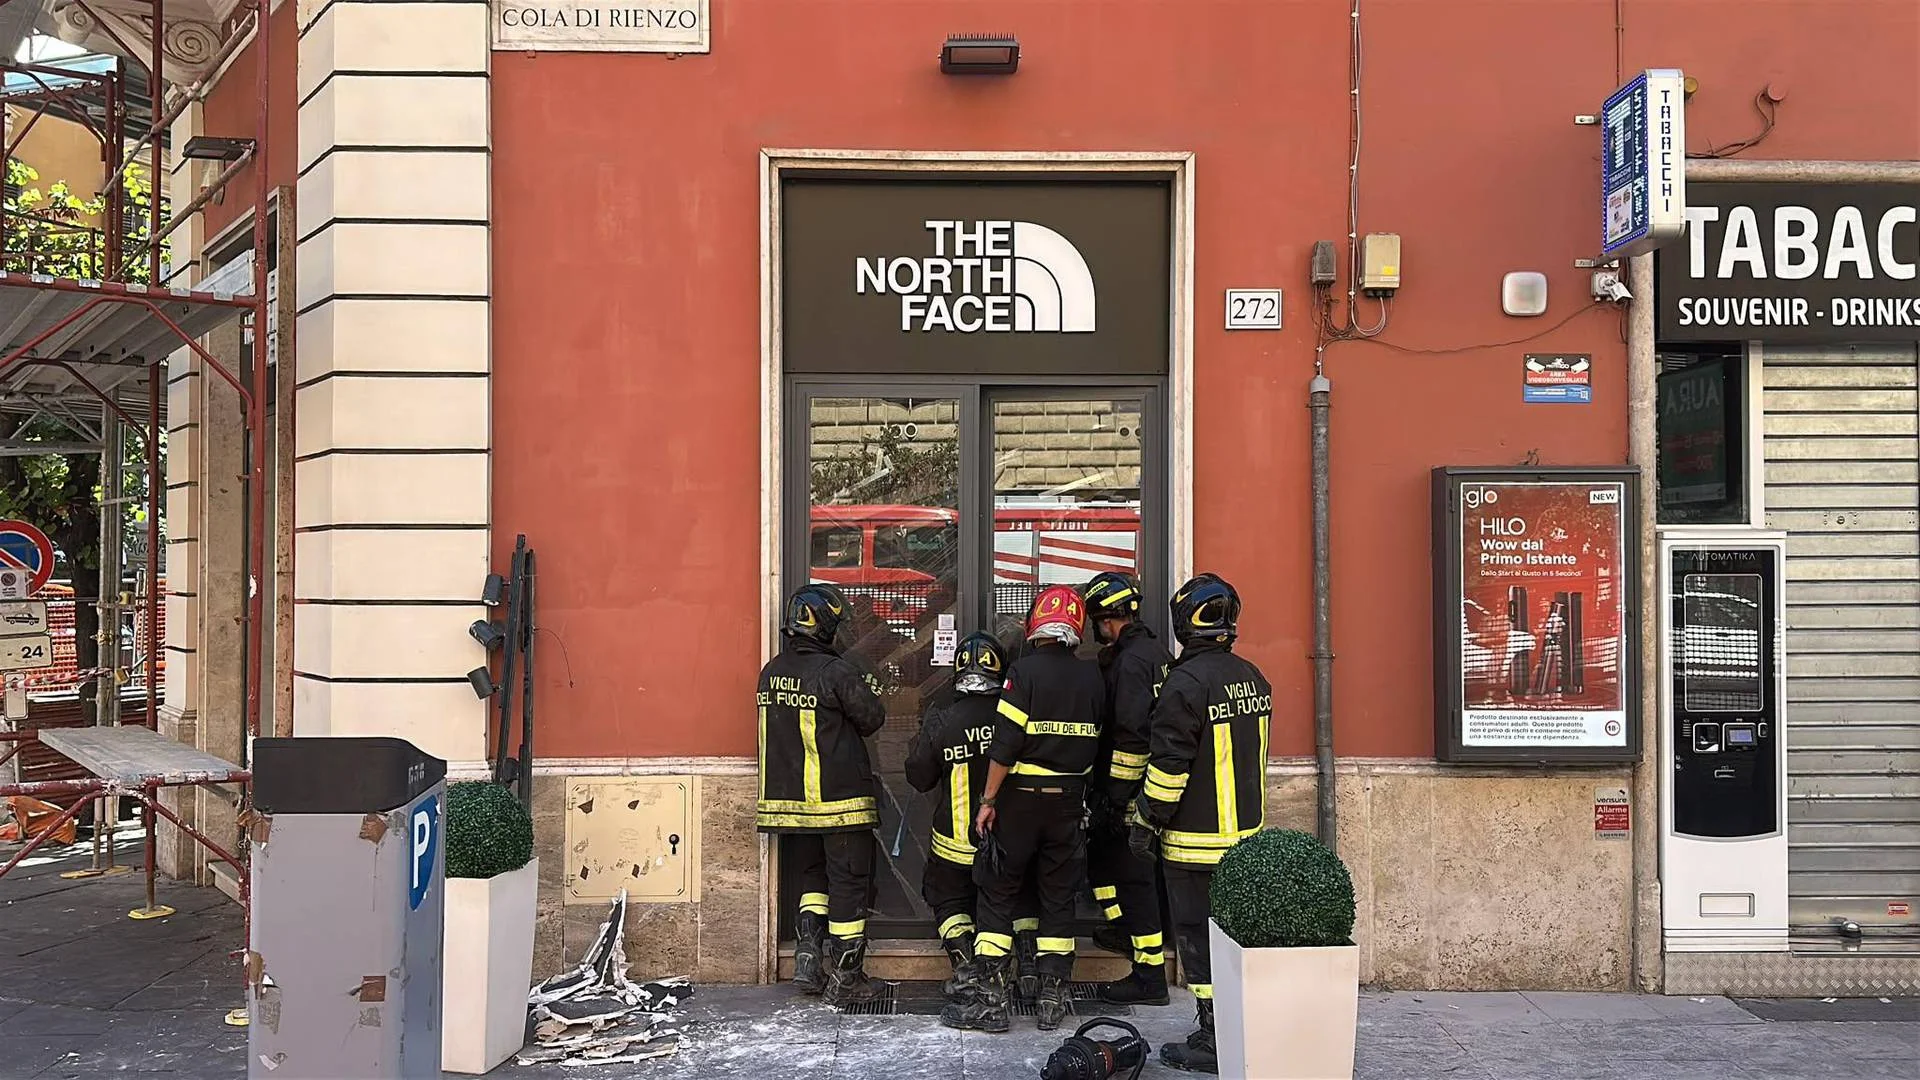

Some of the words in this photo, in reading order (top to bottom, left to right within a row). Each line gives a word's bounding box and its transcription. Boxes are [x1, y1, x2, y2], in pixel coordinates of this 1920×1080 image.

[502, 8, 569, 27] COLA
[575, 9, 600, 28] DI
[609, 9, 697, 29] RIENZO
[1660, 90, 1672, 212] TABACCHI
[925, 220, 1012, 257] THE
[1685, 205, 1917, 280] TABAC
[855, 256, 1012, 294] NORTH
[901, 294, 1012, 333] FACE
[1232, 297, 1276, 320] 272
[1678, 297, 1809, 326] SOUVENIR
[1466, 486, 1498, 509] glo
[1592, 493, 1616, 501] NEW
[1480, 517, 1526, 535] HILO
[1480, 539, 1517, 551] Wow
[1521, 539, 1544, 551] dal
[1480, 553, 1523, 565] Primo
[1527, 553, 1577, 565] Istante
[1691, 552, 1756, 561] AUTOMATIKA
[1050, 596, 1061, 609] 9
[1067, 602, 1078, 616] A
[21, 645, 44, 659] 24
[962, 651, 970, 665] 9
[978, 651, 992, 665] A
[769, 676, 801, 692] VIGILI
[1223, 680, 1257, 700] VIGILI
[756, 692, 772, 706] DEL
[776, 692, 818, 708] FUOCO
[1208, 702, 1235, 722] DEL
[1236, 694, 1272, 716] FUOCO
[1034, 722, 1060, 733] VIGILI
[1062, 723, 1078, 734] DEL
[943, 744, 974, 762] DEL
[980, 740, 993, 755] F
[413, 810, 430, 889] P
